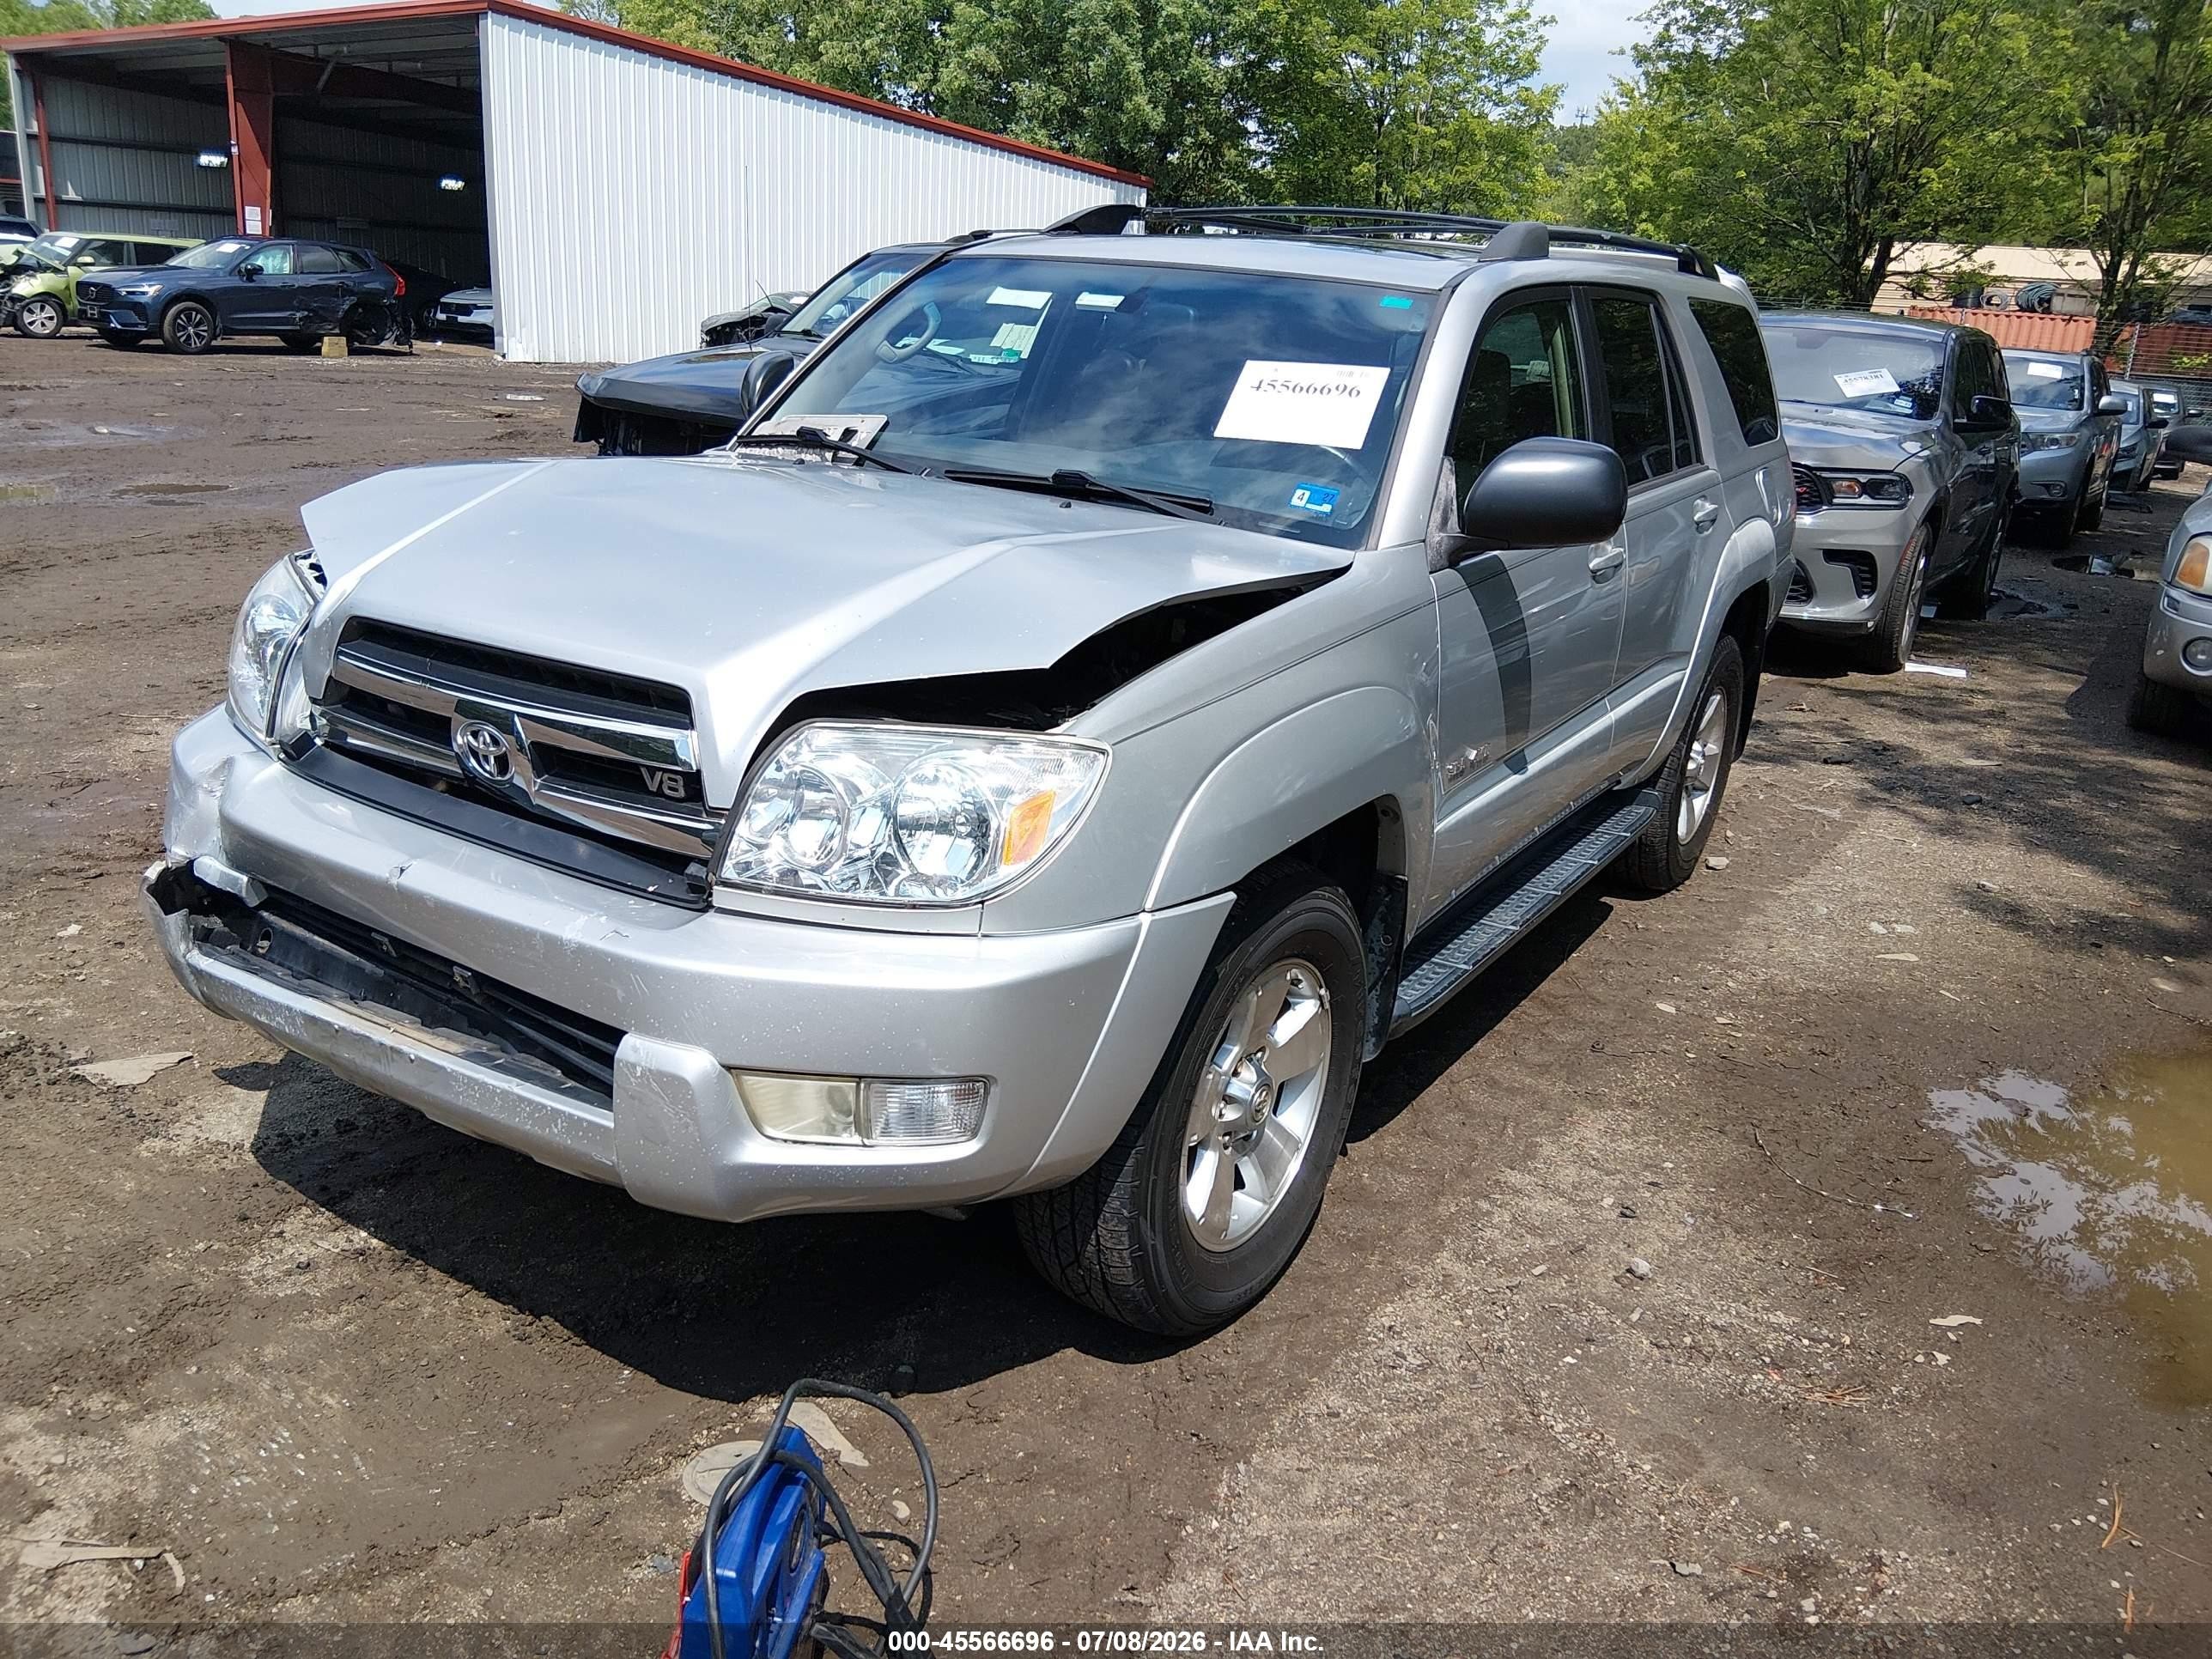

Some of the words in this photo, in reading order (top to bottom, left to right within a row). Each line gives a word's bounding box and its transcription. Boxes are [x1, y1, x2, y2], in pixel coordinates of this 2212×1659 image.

[1250, 378, 1362, 398] 45566696
[1297, 491, 1306, 502] 4
[1322, 492, 1335, 502] 27
[640, 766, 685, 799] V8
